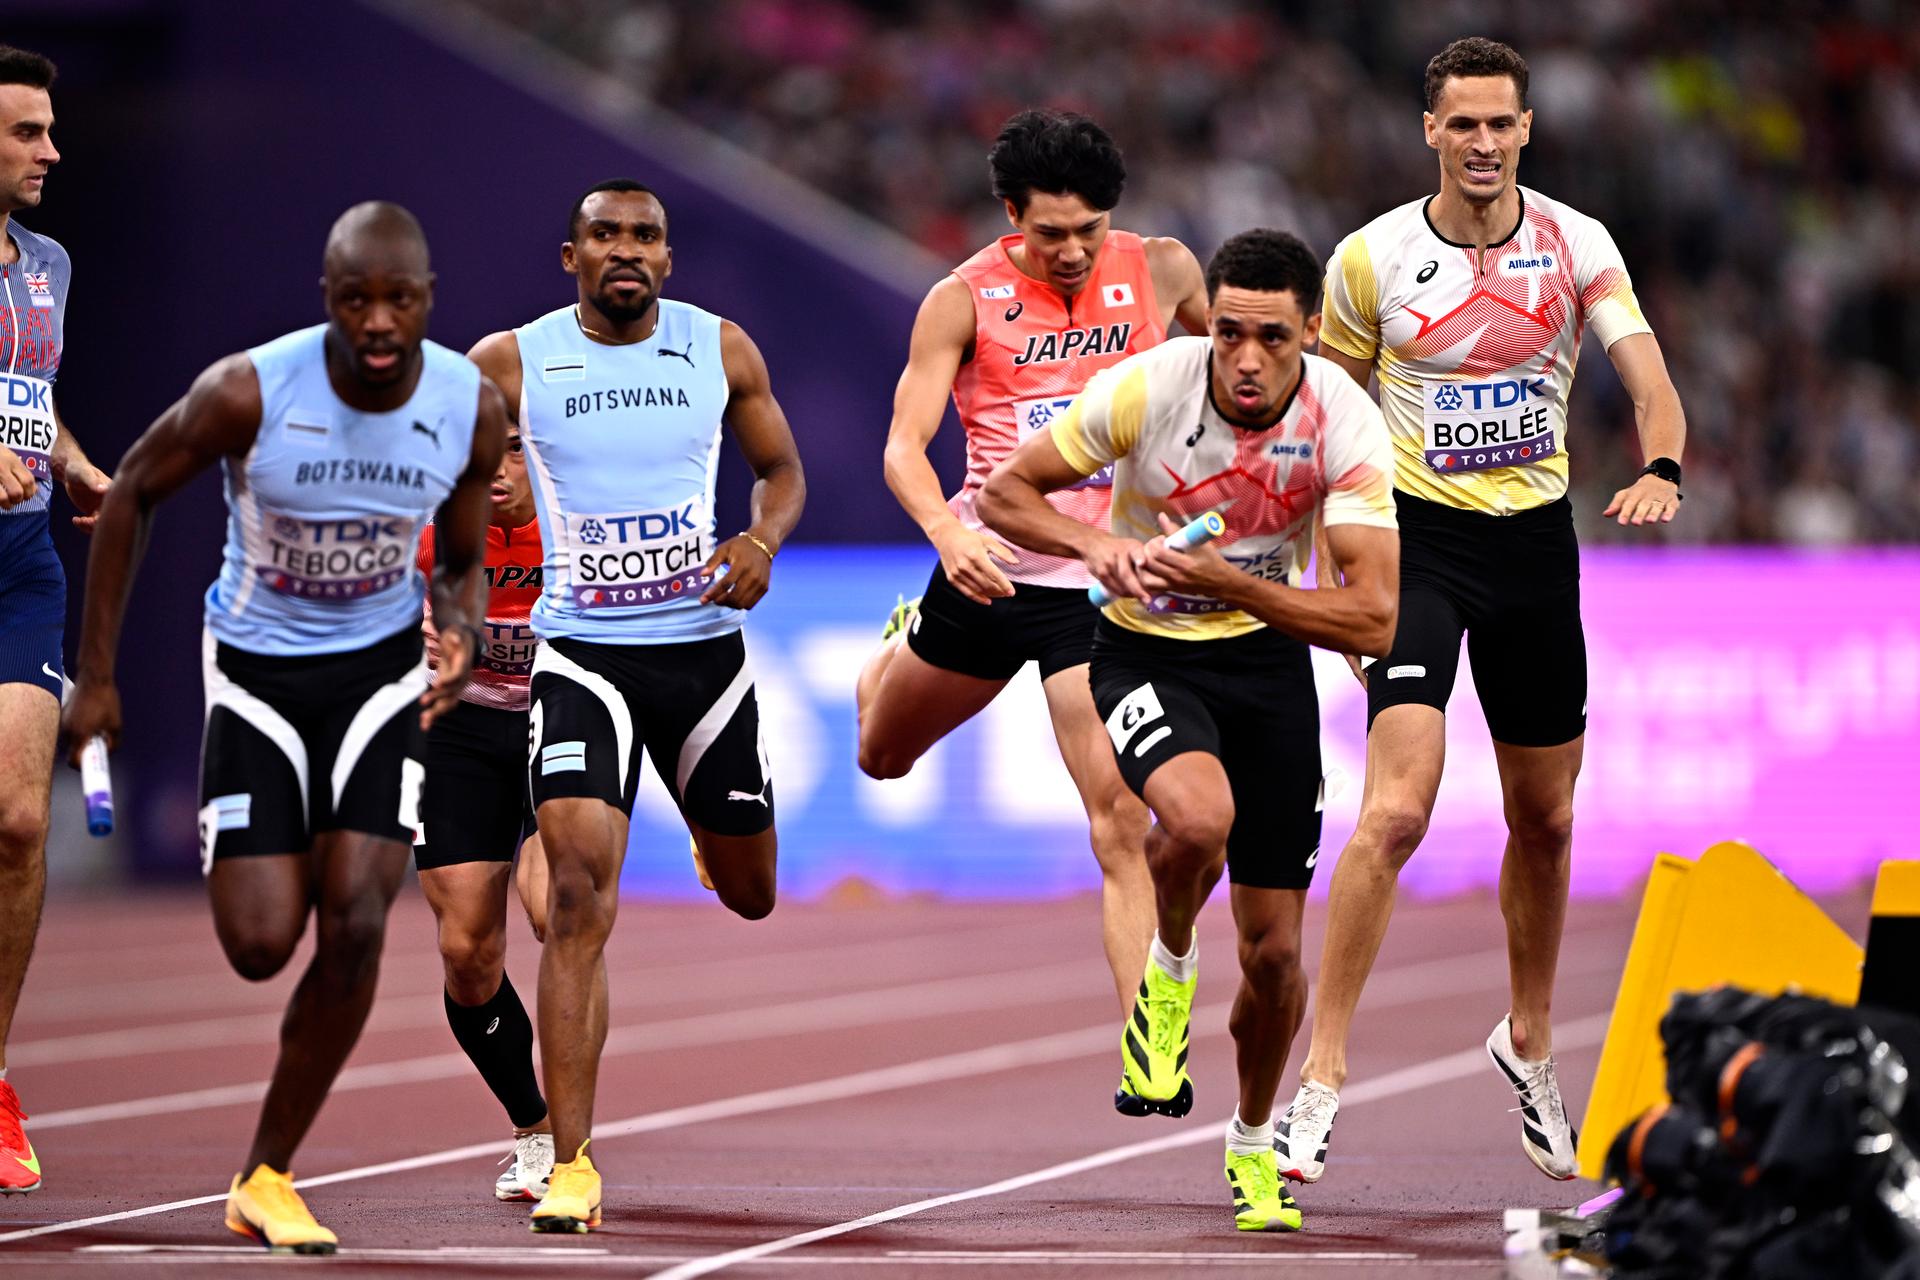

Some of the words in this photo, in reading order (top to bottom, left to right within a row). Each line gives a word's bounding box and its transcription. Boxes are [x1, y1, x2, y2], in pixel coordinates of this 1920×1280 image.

[1013, 322, 1131, 365] JAPAN
[565, 387, 690, 418] BOTSWANA
[1461, 377, 1546, 410] TDK
[1434, 406, 1548, 447] BORLÉE
[295, 458, 426, 489] BOTSWANA
[303, 519, 401, 543] TDK
[605, 503, 697, 543] TDK
[268, 538, 401, 575] TEBOGO
[579, 536, 701, 581] SCOTCH
